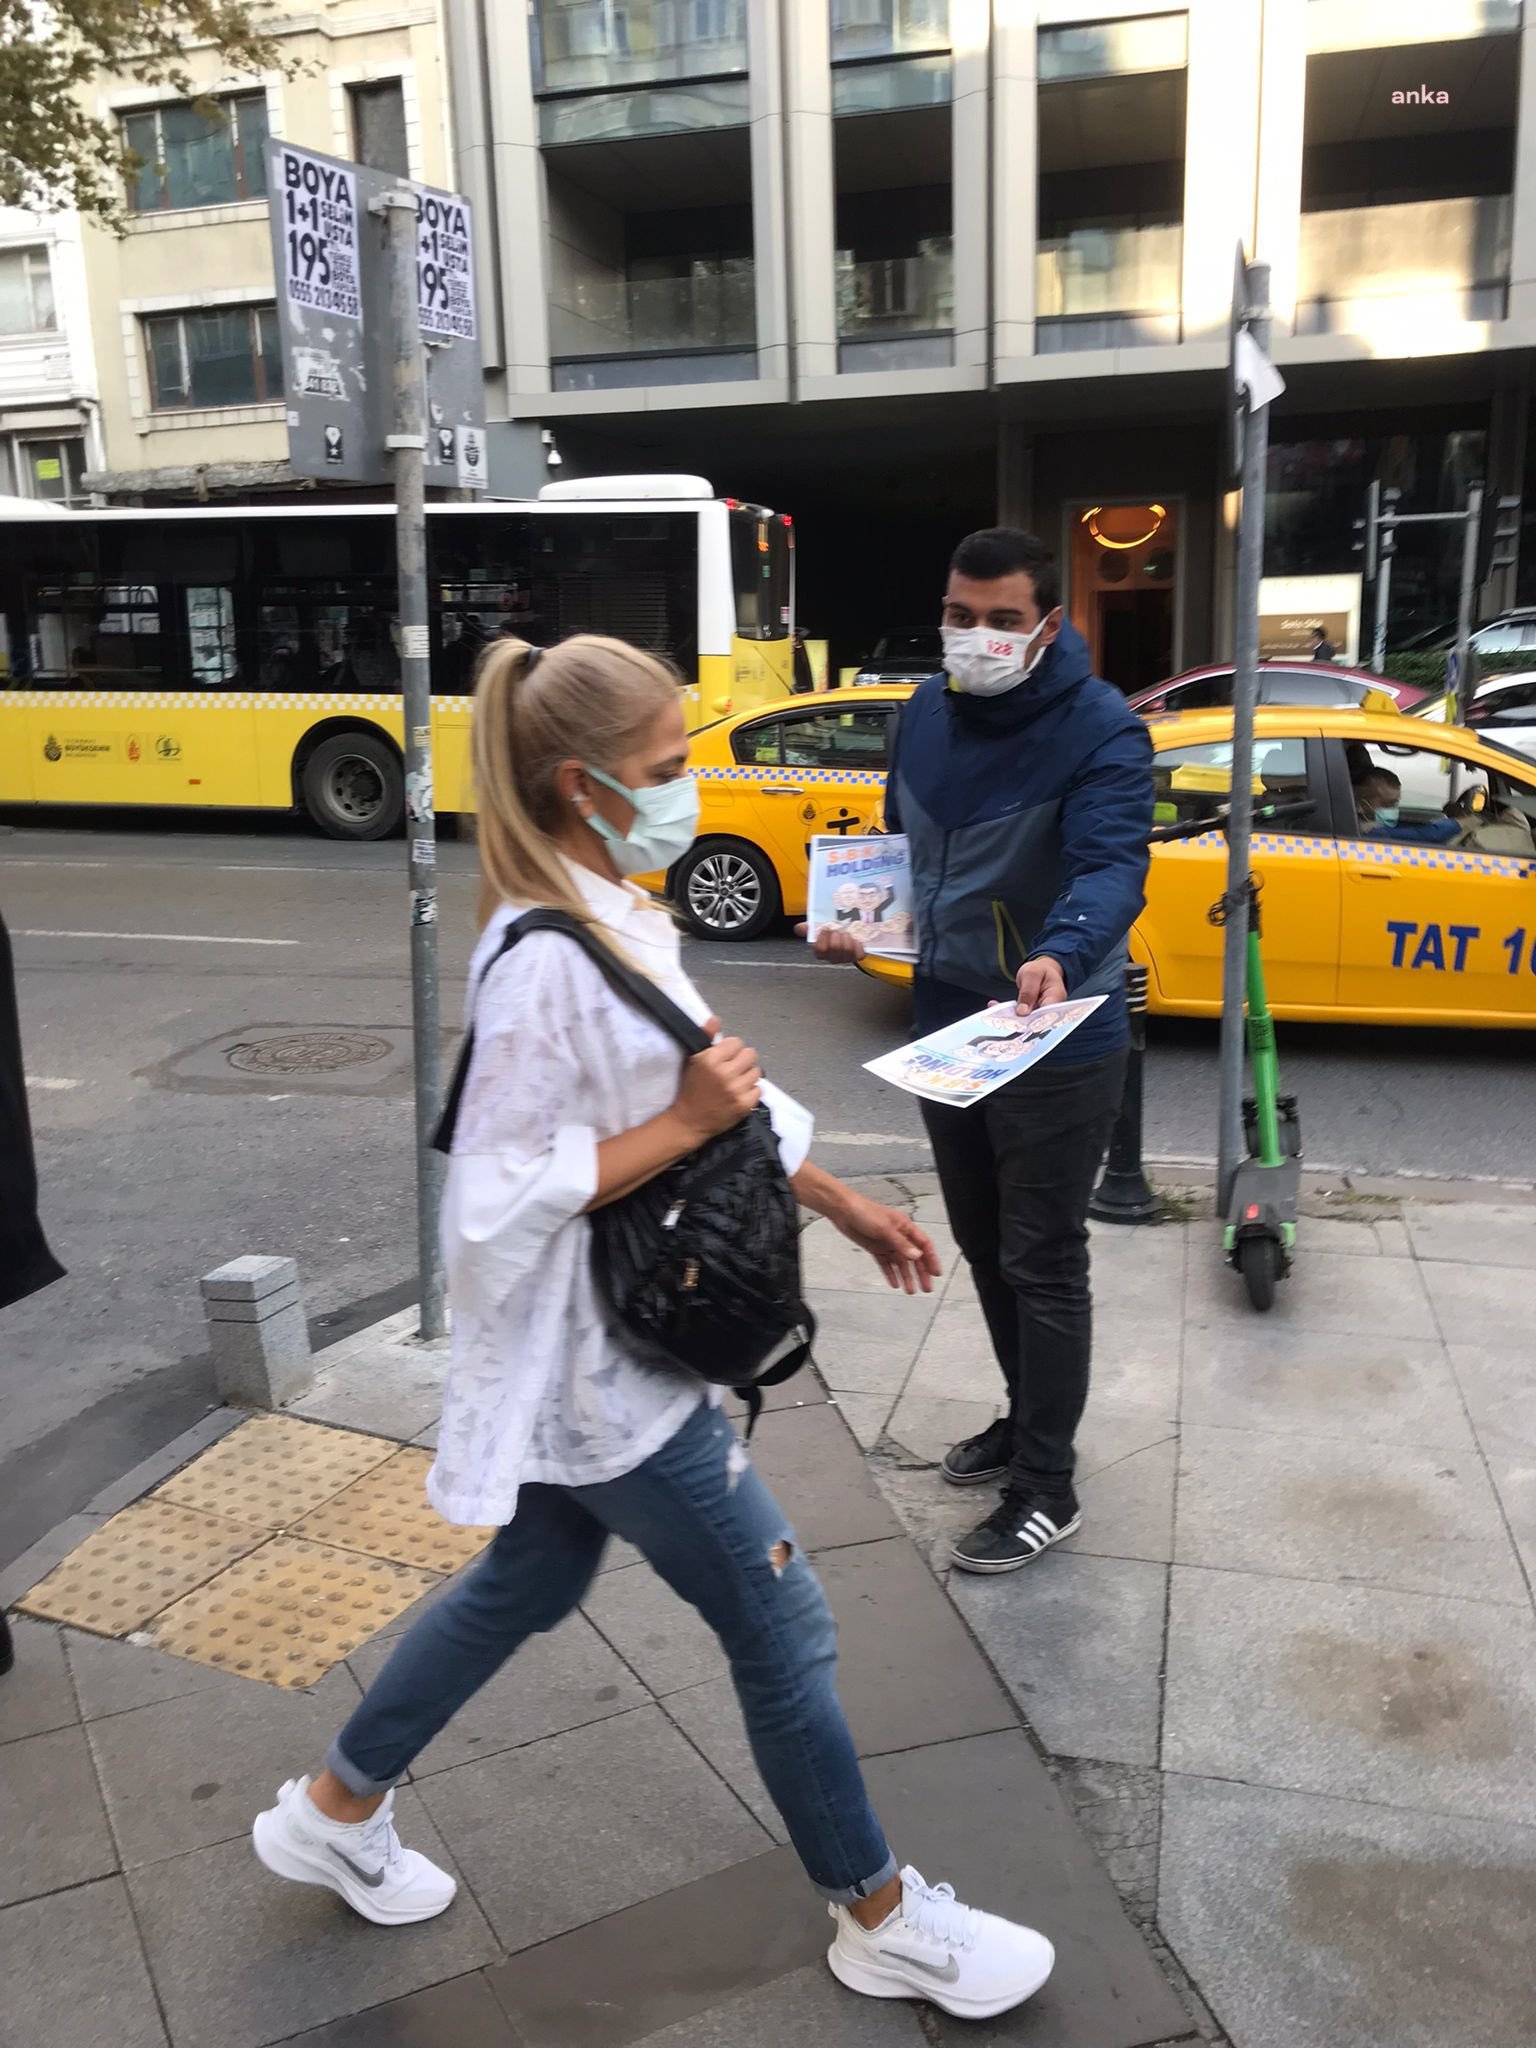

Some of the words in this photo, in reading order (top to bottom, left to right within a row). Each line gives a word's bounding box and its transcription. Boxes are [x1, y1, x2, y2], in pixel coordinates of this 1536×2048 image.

[284, 153, 352, 208] BOYA
[286, 189, 318, 232] 1+1
[288, 229, 330, 286] 195
[986, 640, 1013, 656] 128
[1387, 920, 1481, 973] TAT
[1503, 927, 1536, 976] 1
